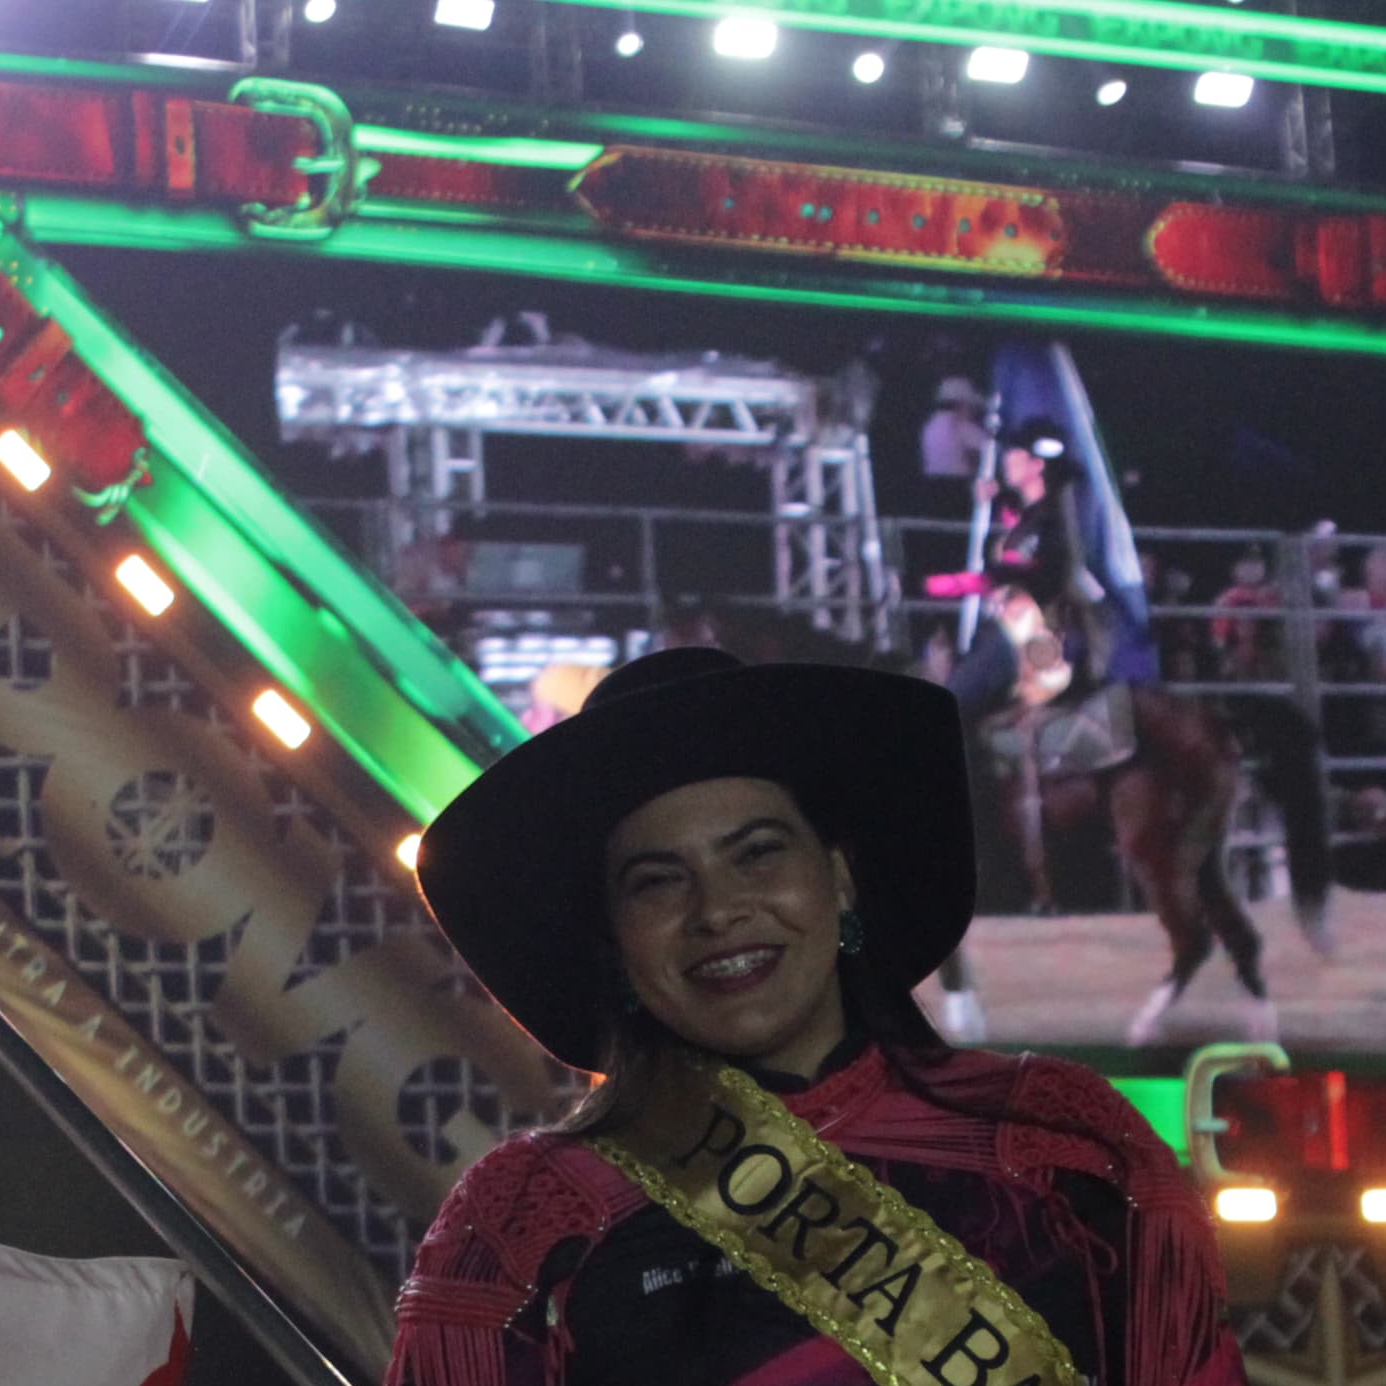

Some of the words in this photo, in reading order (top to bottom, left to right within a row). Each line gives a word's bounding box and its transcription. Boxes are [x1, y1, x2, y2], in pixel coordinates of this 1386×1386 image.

[79, 1014, 104, 1041] A
[118, 1046, 309, 1240] INDUSTRIA
[672, 1108, 925, 1337] PORTA
